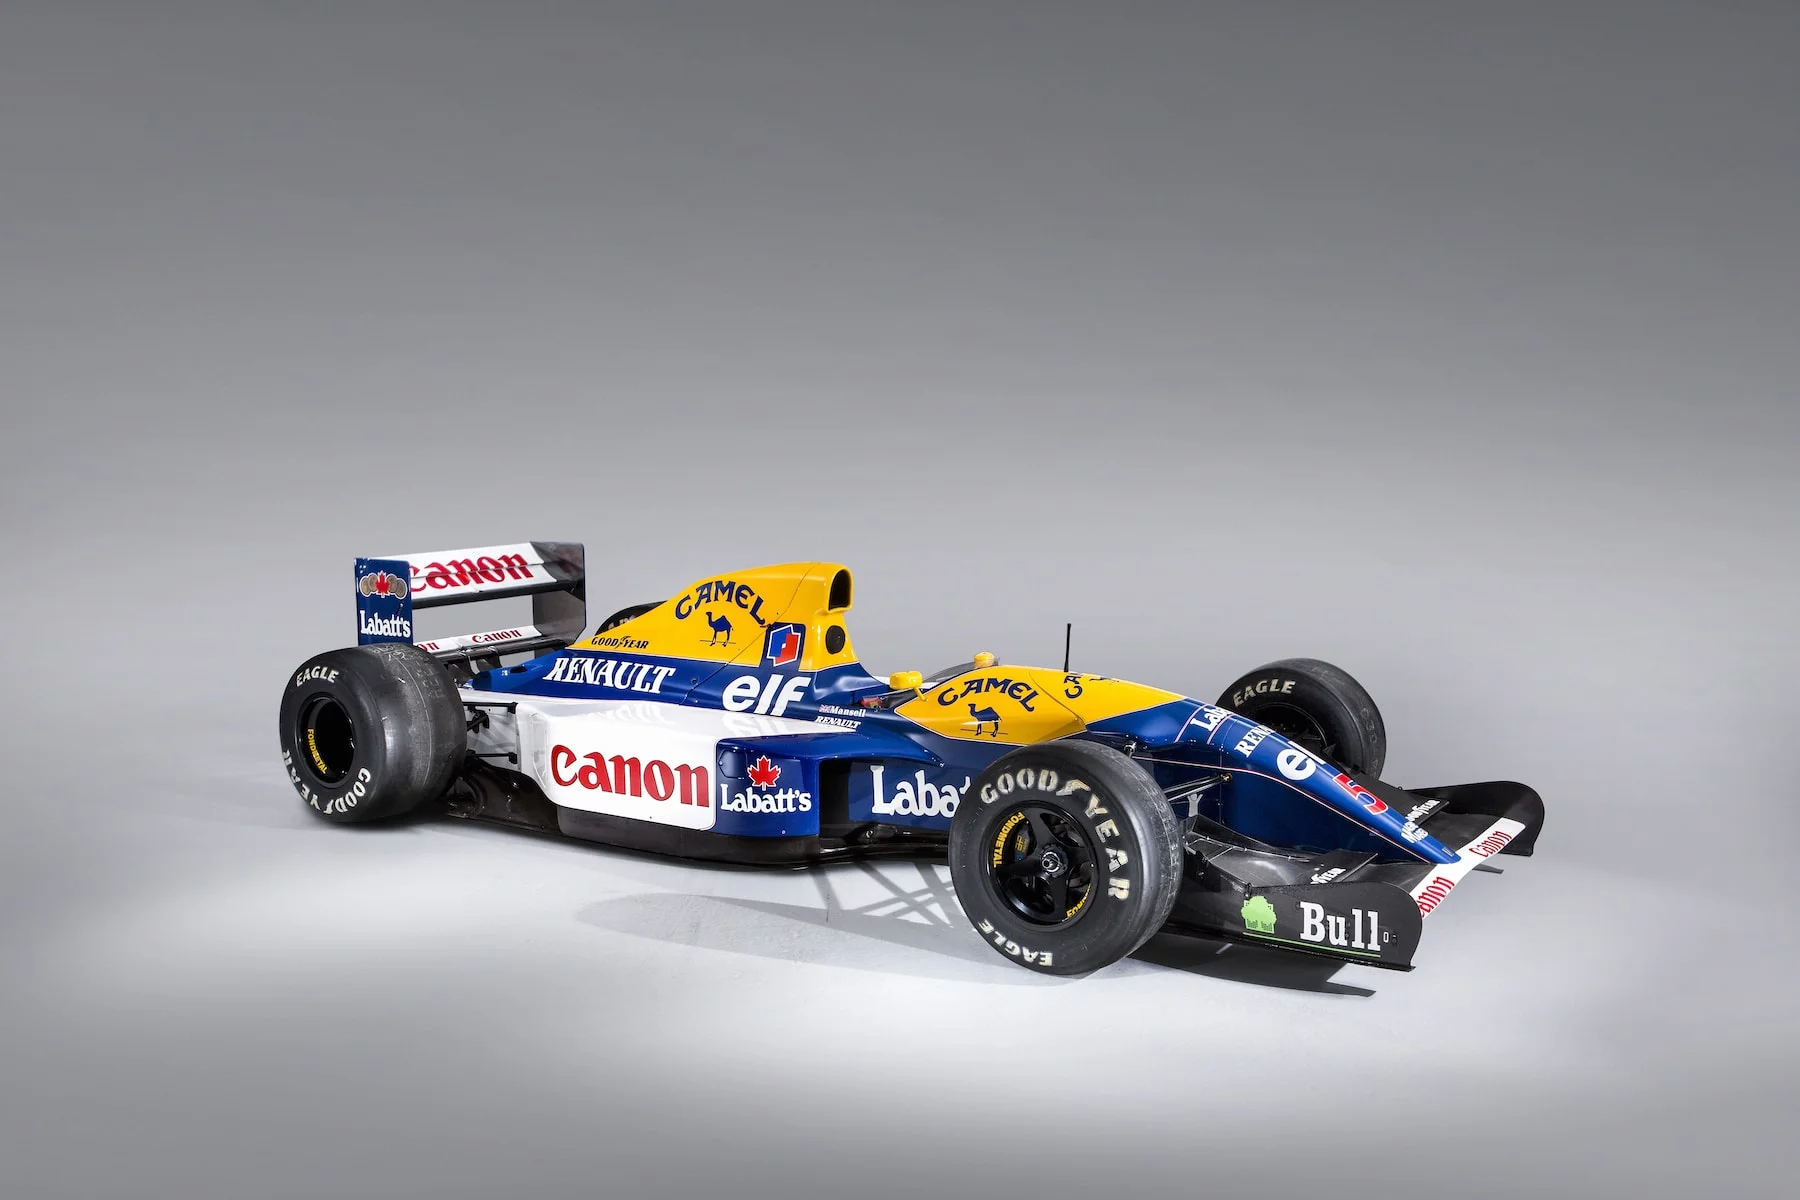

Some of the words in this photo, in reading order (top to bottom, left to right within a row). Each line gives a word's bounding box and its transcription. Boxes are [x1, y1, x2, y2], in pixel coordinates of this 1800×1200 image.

[674, 580, 767, 625] CAMEL
[359, 609, 411, 638] Labatt's
[472, 626, 522, 643] Canon
[296, 665, 339, 687] EAGLE
[542, 657, 676, 694] RENAULT
[1232, 678, 1296, 708] EAGLE
[721, 673, 813, 716] elf
[830, 705, 866, 717] Mansell
[937, 677, 1039, 712] CAMEL
[815, 715, 862, 729] RENAULT
[307, 728, 328, 775] FONDMETAL
[549, 744, 710, 808] Canon
[1332, 772, 1389, 816] 5
[720, 783, 812, 814] Labatt's
[993, 811, 1026, 869] FONDMETAL
[1468, 830, 1513, 858] Canon
[1416, 876, 1455, 918] anon
[977, 918, 1053, 967] EAGLE
[1299, 901, 1381, 951] Bull
